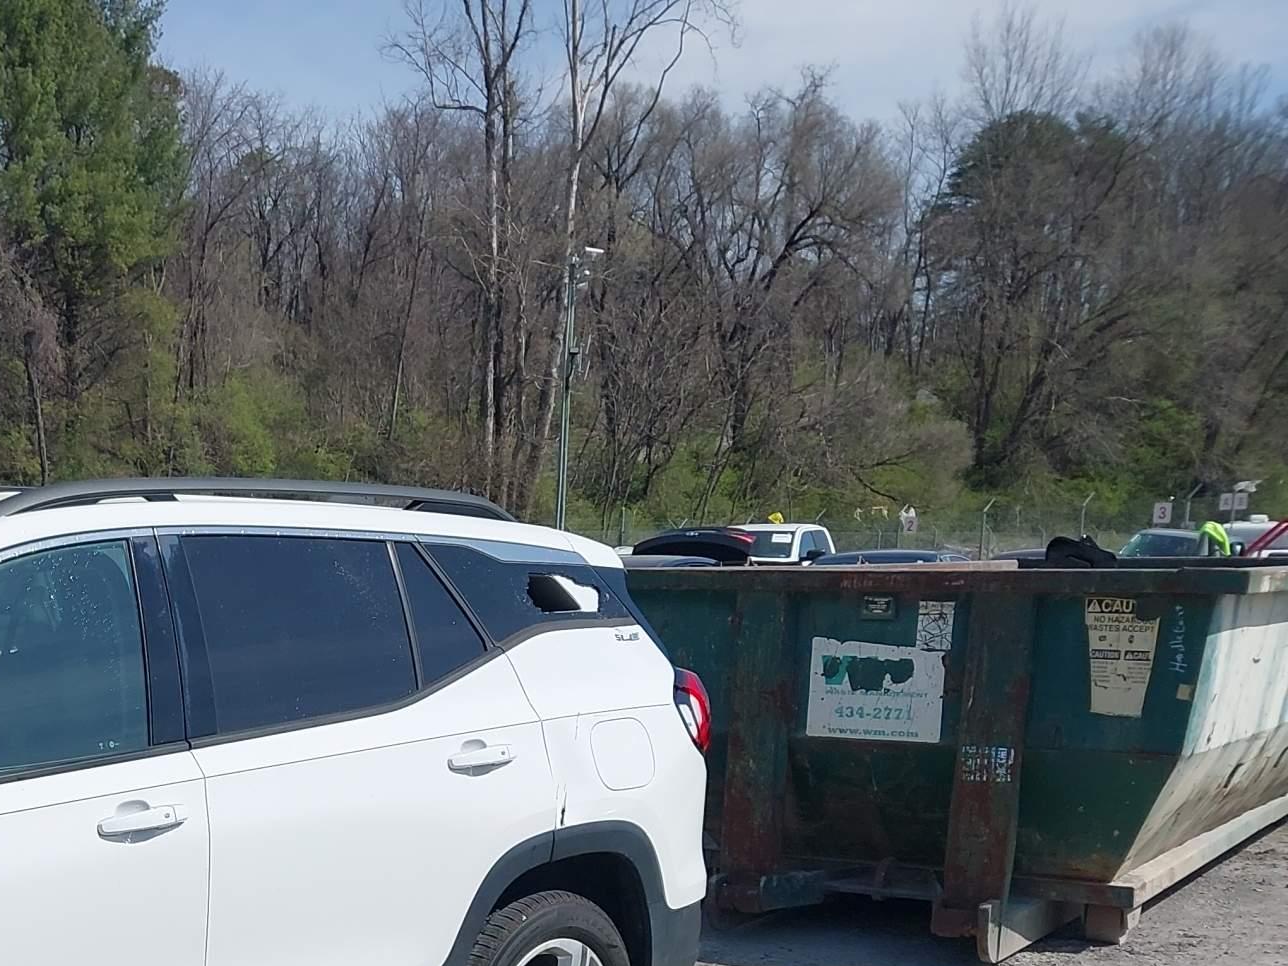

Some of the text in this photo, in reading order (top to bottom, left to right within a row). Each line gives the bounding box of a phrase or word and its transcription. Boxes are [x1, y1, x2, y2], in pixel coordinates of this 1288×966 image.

[1158, 506, 1167, 520] 3
[906, 520, 914, 532] 2
[1101, 599, 1136, 613] CAU
[1094, 616, 1107, 624] NO
[834, 703, 912, 721] 434-2771
[828, 727, 919, 738] www.wm.com
